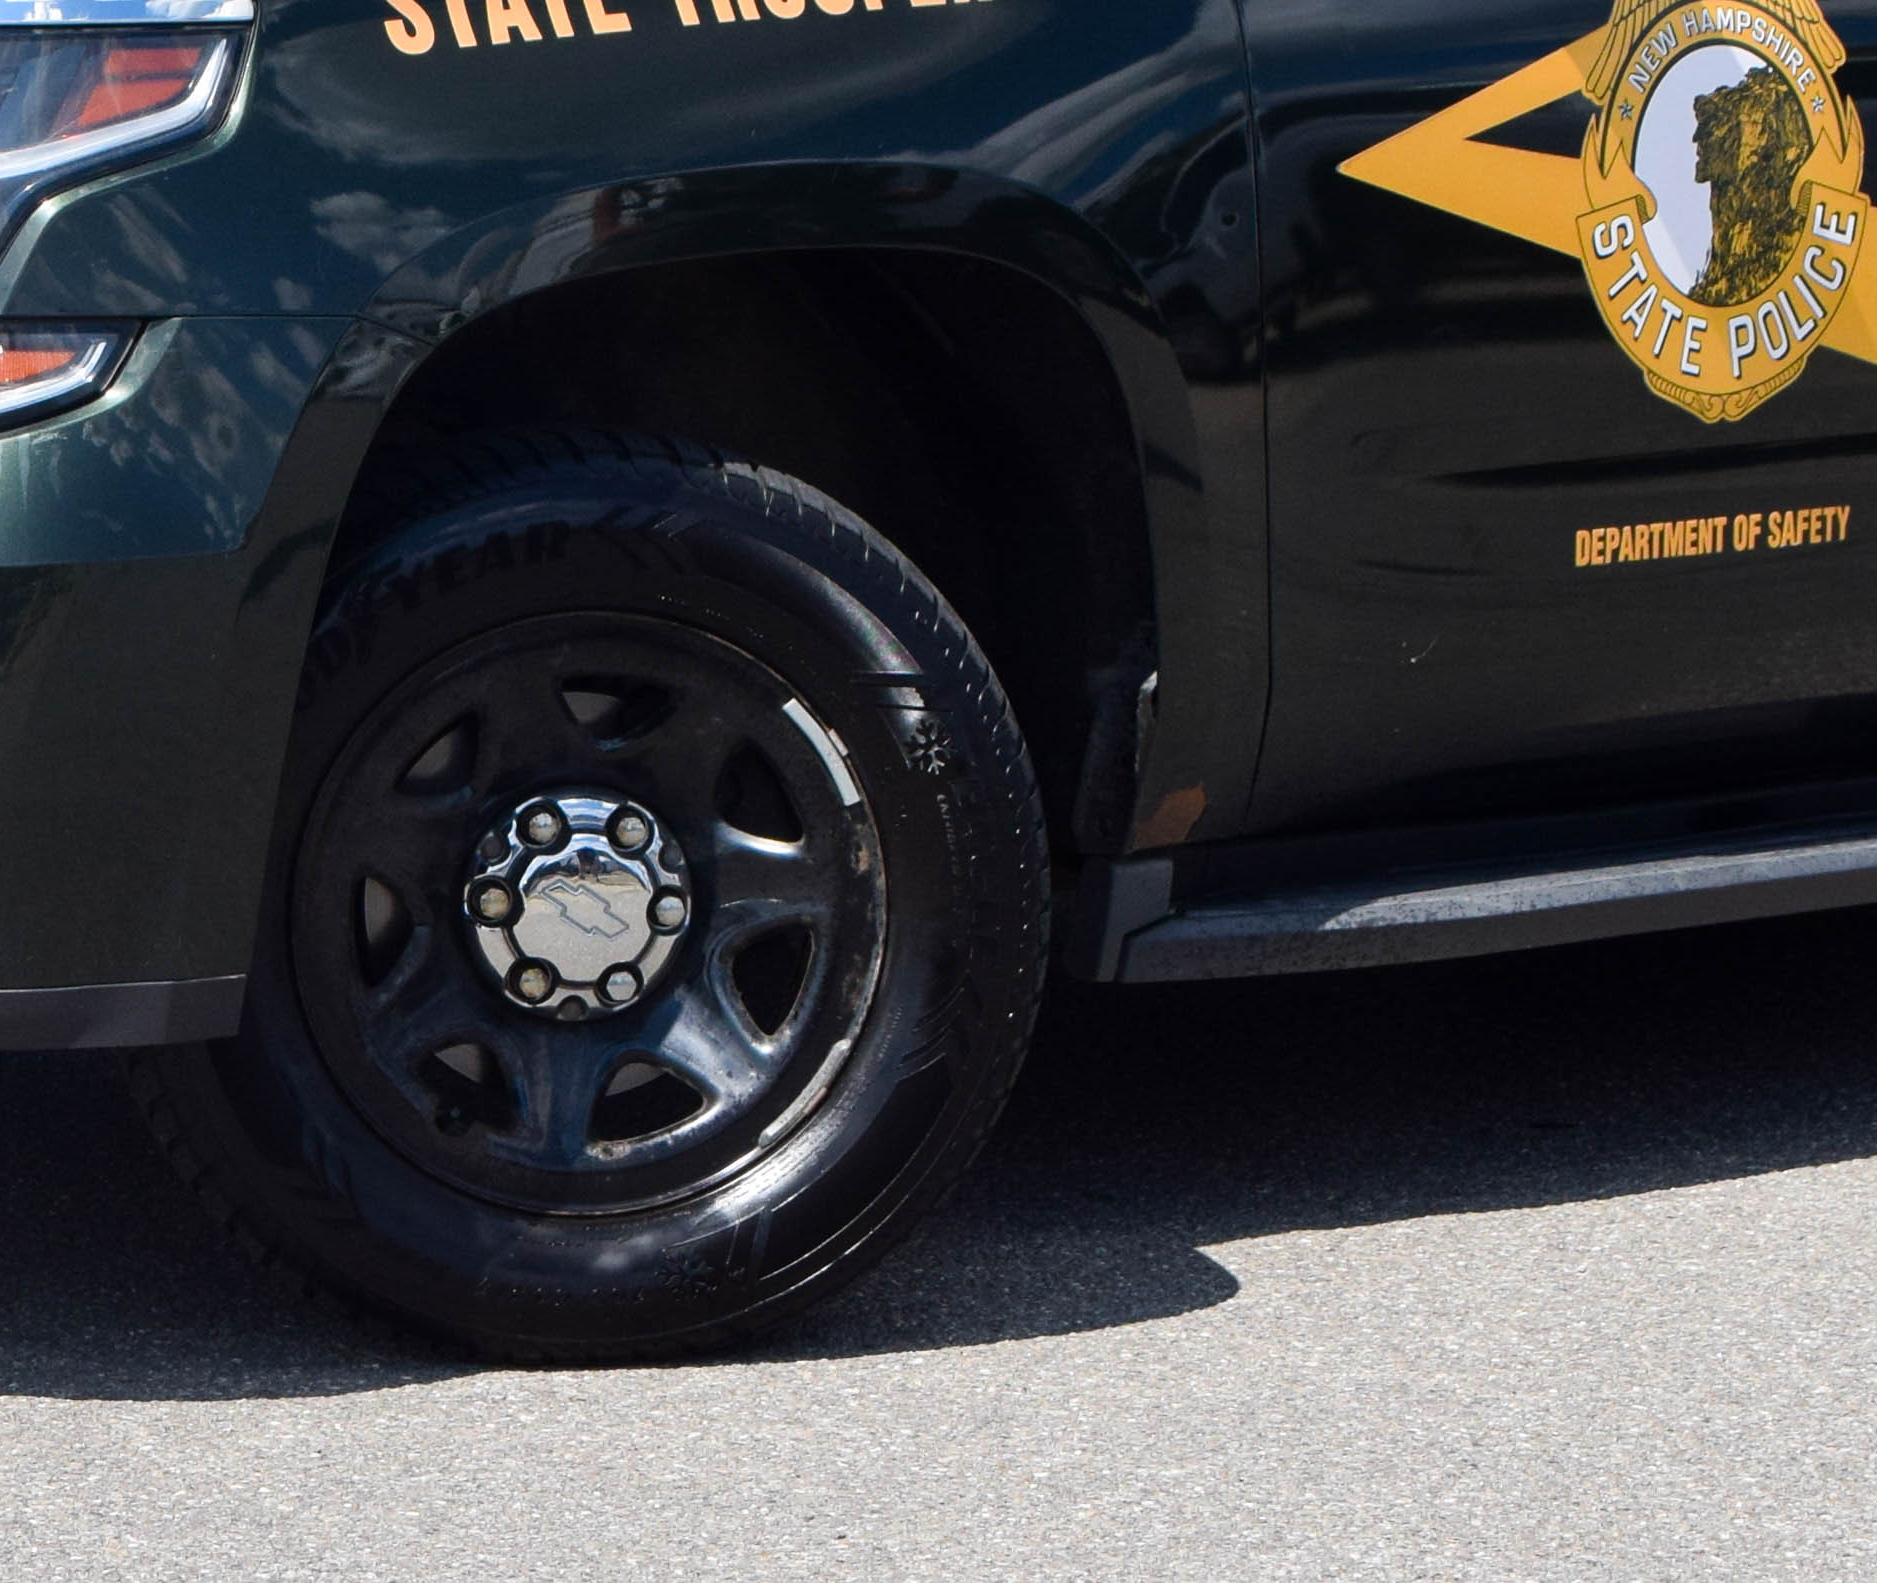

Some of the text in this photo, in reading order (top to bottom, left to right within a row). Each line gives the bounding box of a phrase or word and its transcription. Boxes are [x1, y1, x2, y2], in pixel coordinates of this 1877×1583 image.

[1626, 6, 1818, 94] NEW HAMPSHIRE
[1591, 201, 1859, 380] STATE POLICE
[1575, 505, 1850, 568] DEPARTMENT OF SAFETY
